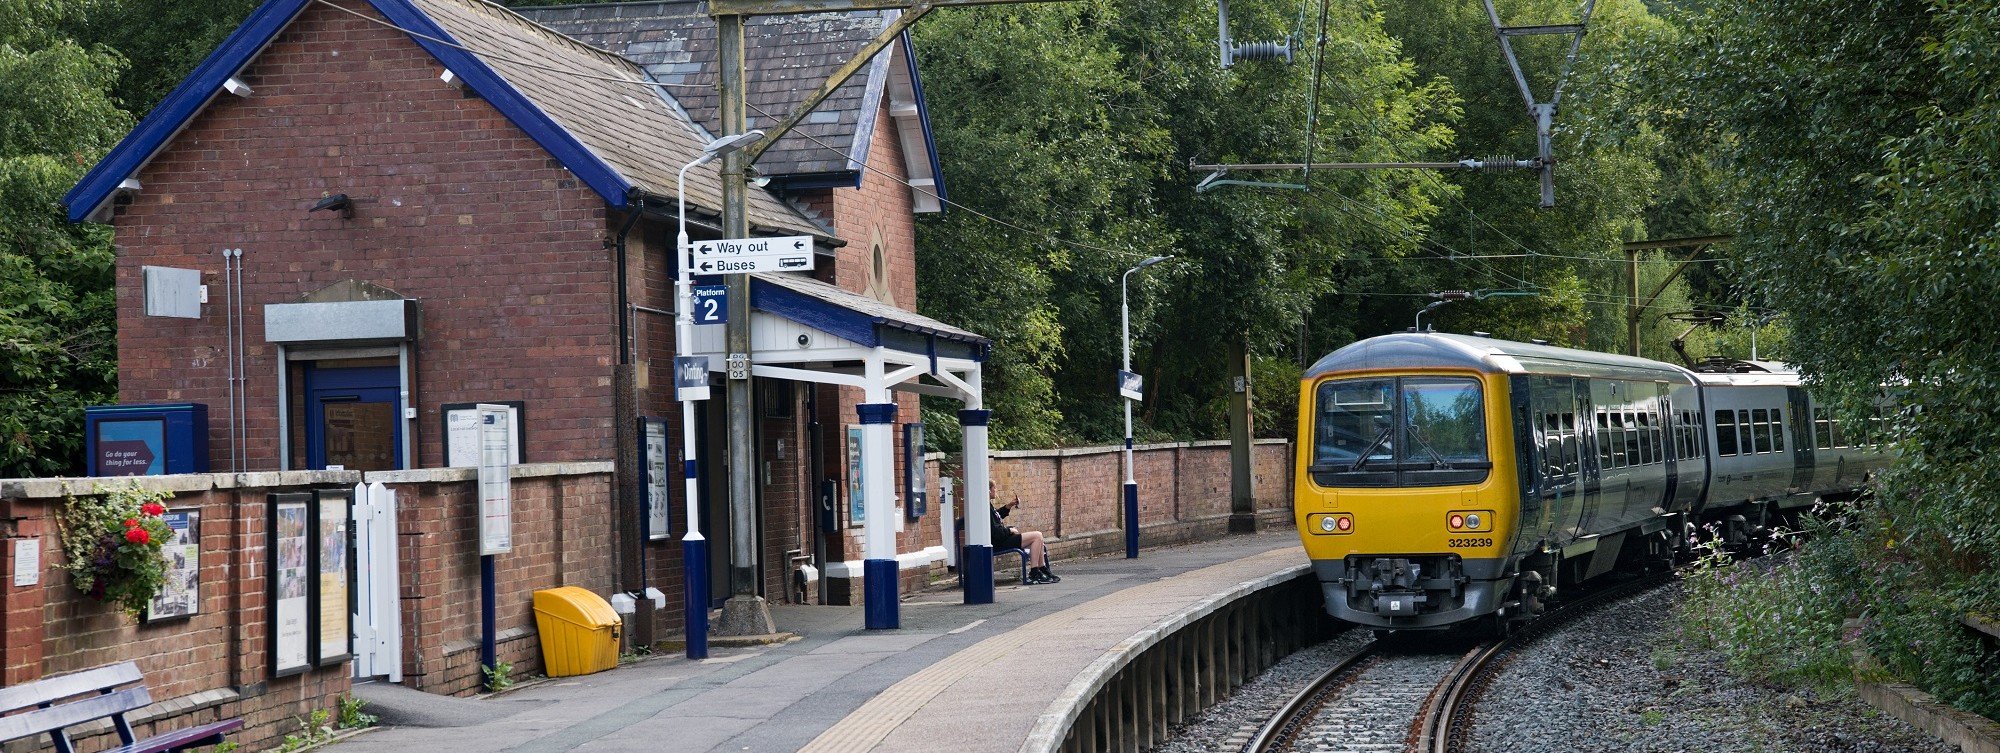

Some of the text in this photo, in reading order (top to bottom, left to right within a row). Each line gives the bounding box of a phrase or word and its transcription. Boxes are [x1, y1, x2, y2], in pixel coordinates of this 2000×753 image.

[717, 241, 769, 255] Way out
[717, 260, 756, 271] Buses
[696, 289, 725, 297] Platform
[704, 298, 719, 321] 2
[732, 361, 744, 369] 00
[684, 363, 704, 384] Dinting
[1448, 538, 1493, 547] 323239
